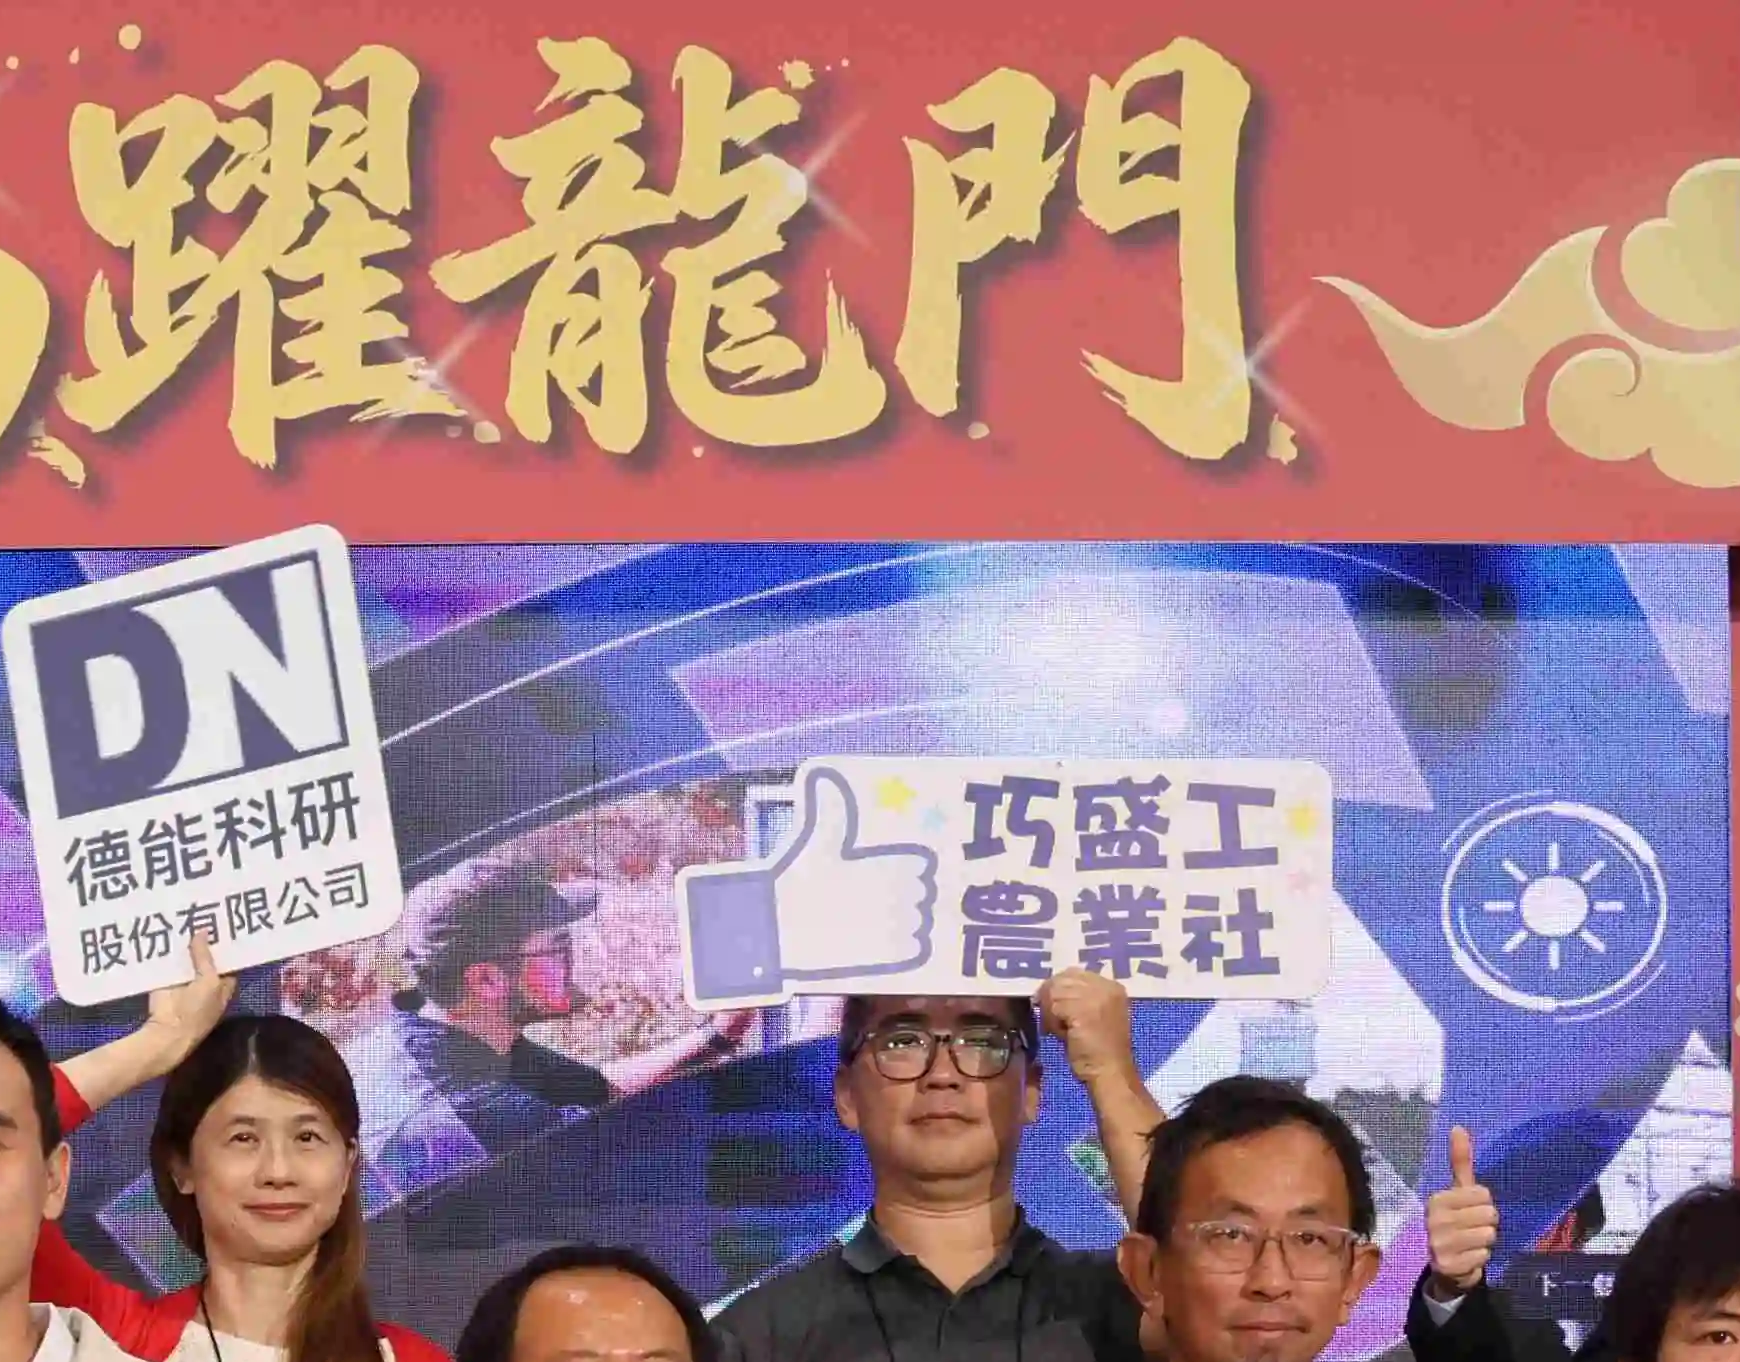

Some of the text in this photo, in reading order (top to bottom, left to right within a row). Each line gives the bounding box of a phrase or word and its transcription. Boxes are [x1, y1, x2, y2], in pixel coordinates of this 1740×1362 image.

[28, 552, 348, 820] DN
[61, 770, 364, 906] 德能科研
[961, 775, 1282, 873] 巧盛工
[77, 862, 370, 976] 股份有限公司
[961, 879, 1282, 981] 農業社
